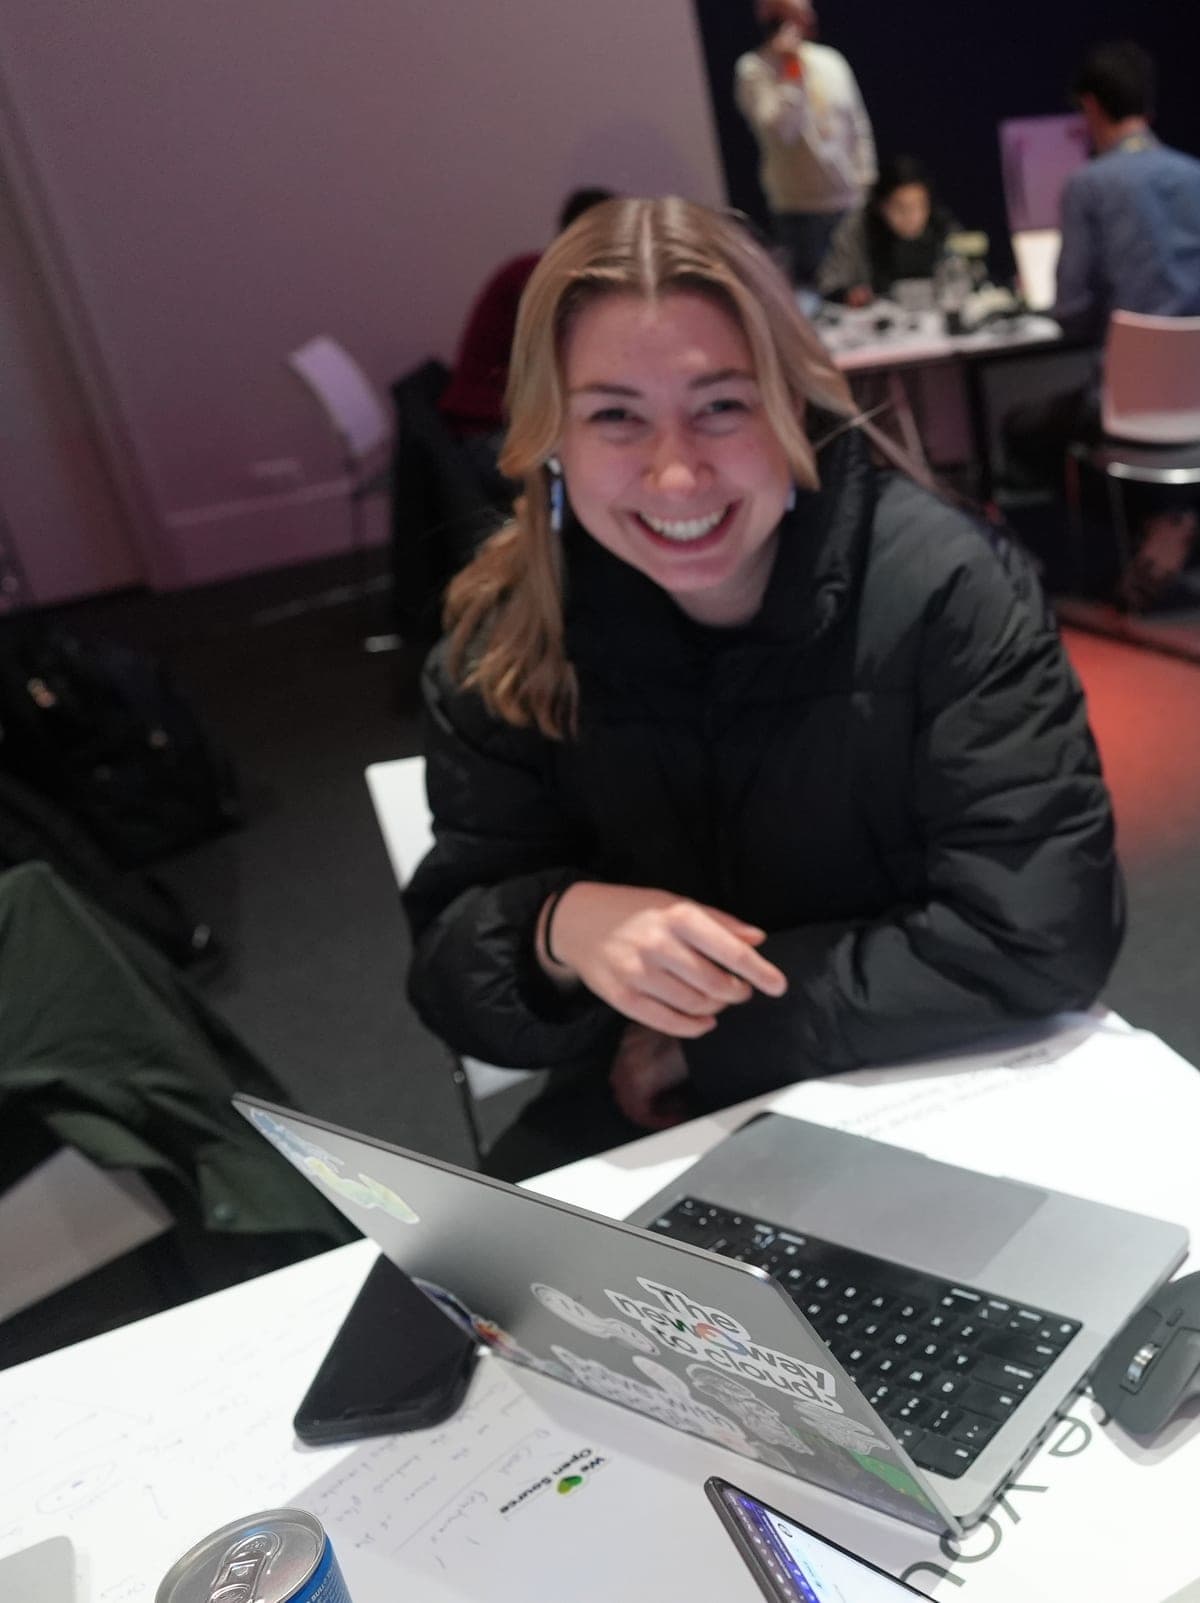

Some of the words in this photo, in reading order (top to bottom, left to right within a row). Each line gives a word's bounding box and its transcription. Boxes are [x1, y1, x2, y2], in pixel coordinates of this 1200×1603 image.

[648, 1284, 740, 1334] The
[614, 1296, 706, 1339] new
[750, 1347, 825, 1390] way
[652, 1325, 698, 1355] to
[704, 1348, 834, 1407] cloud.
[553, 1448, 592, 1476] Open
[581, 1457, 606, 1473] We
[499, 1475, 553, 1514] Source
